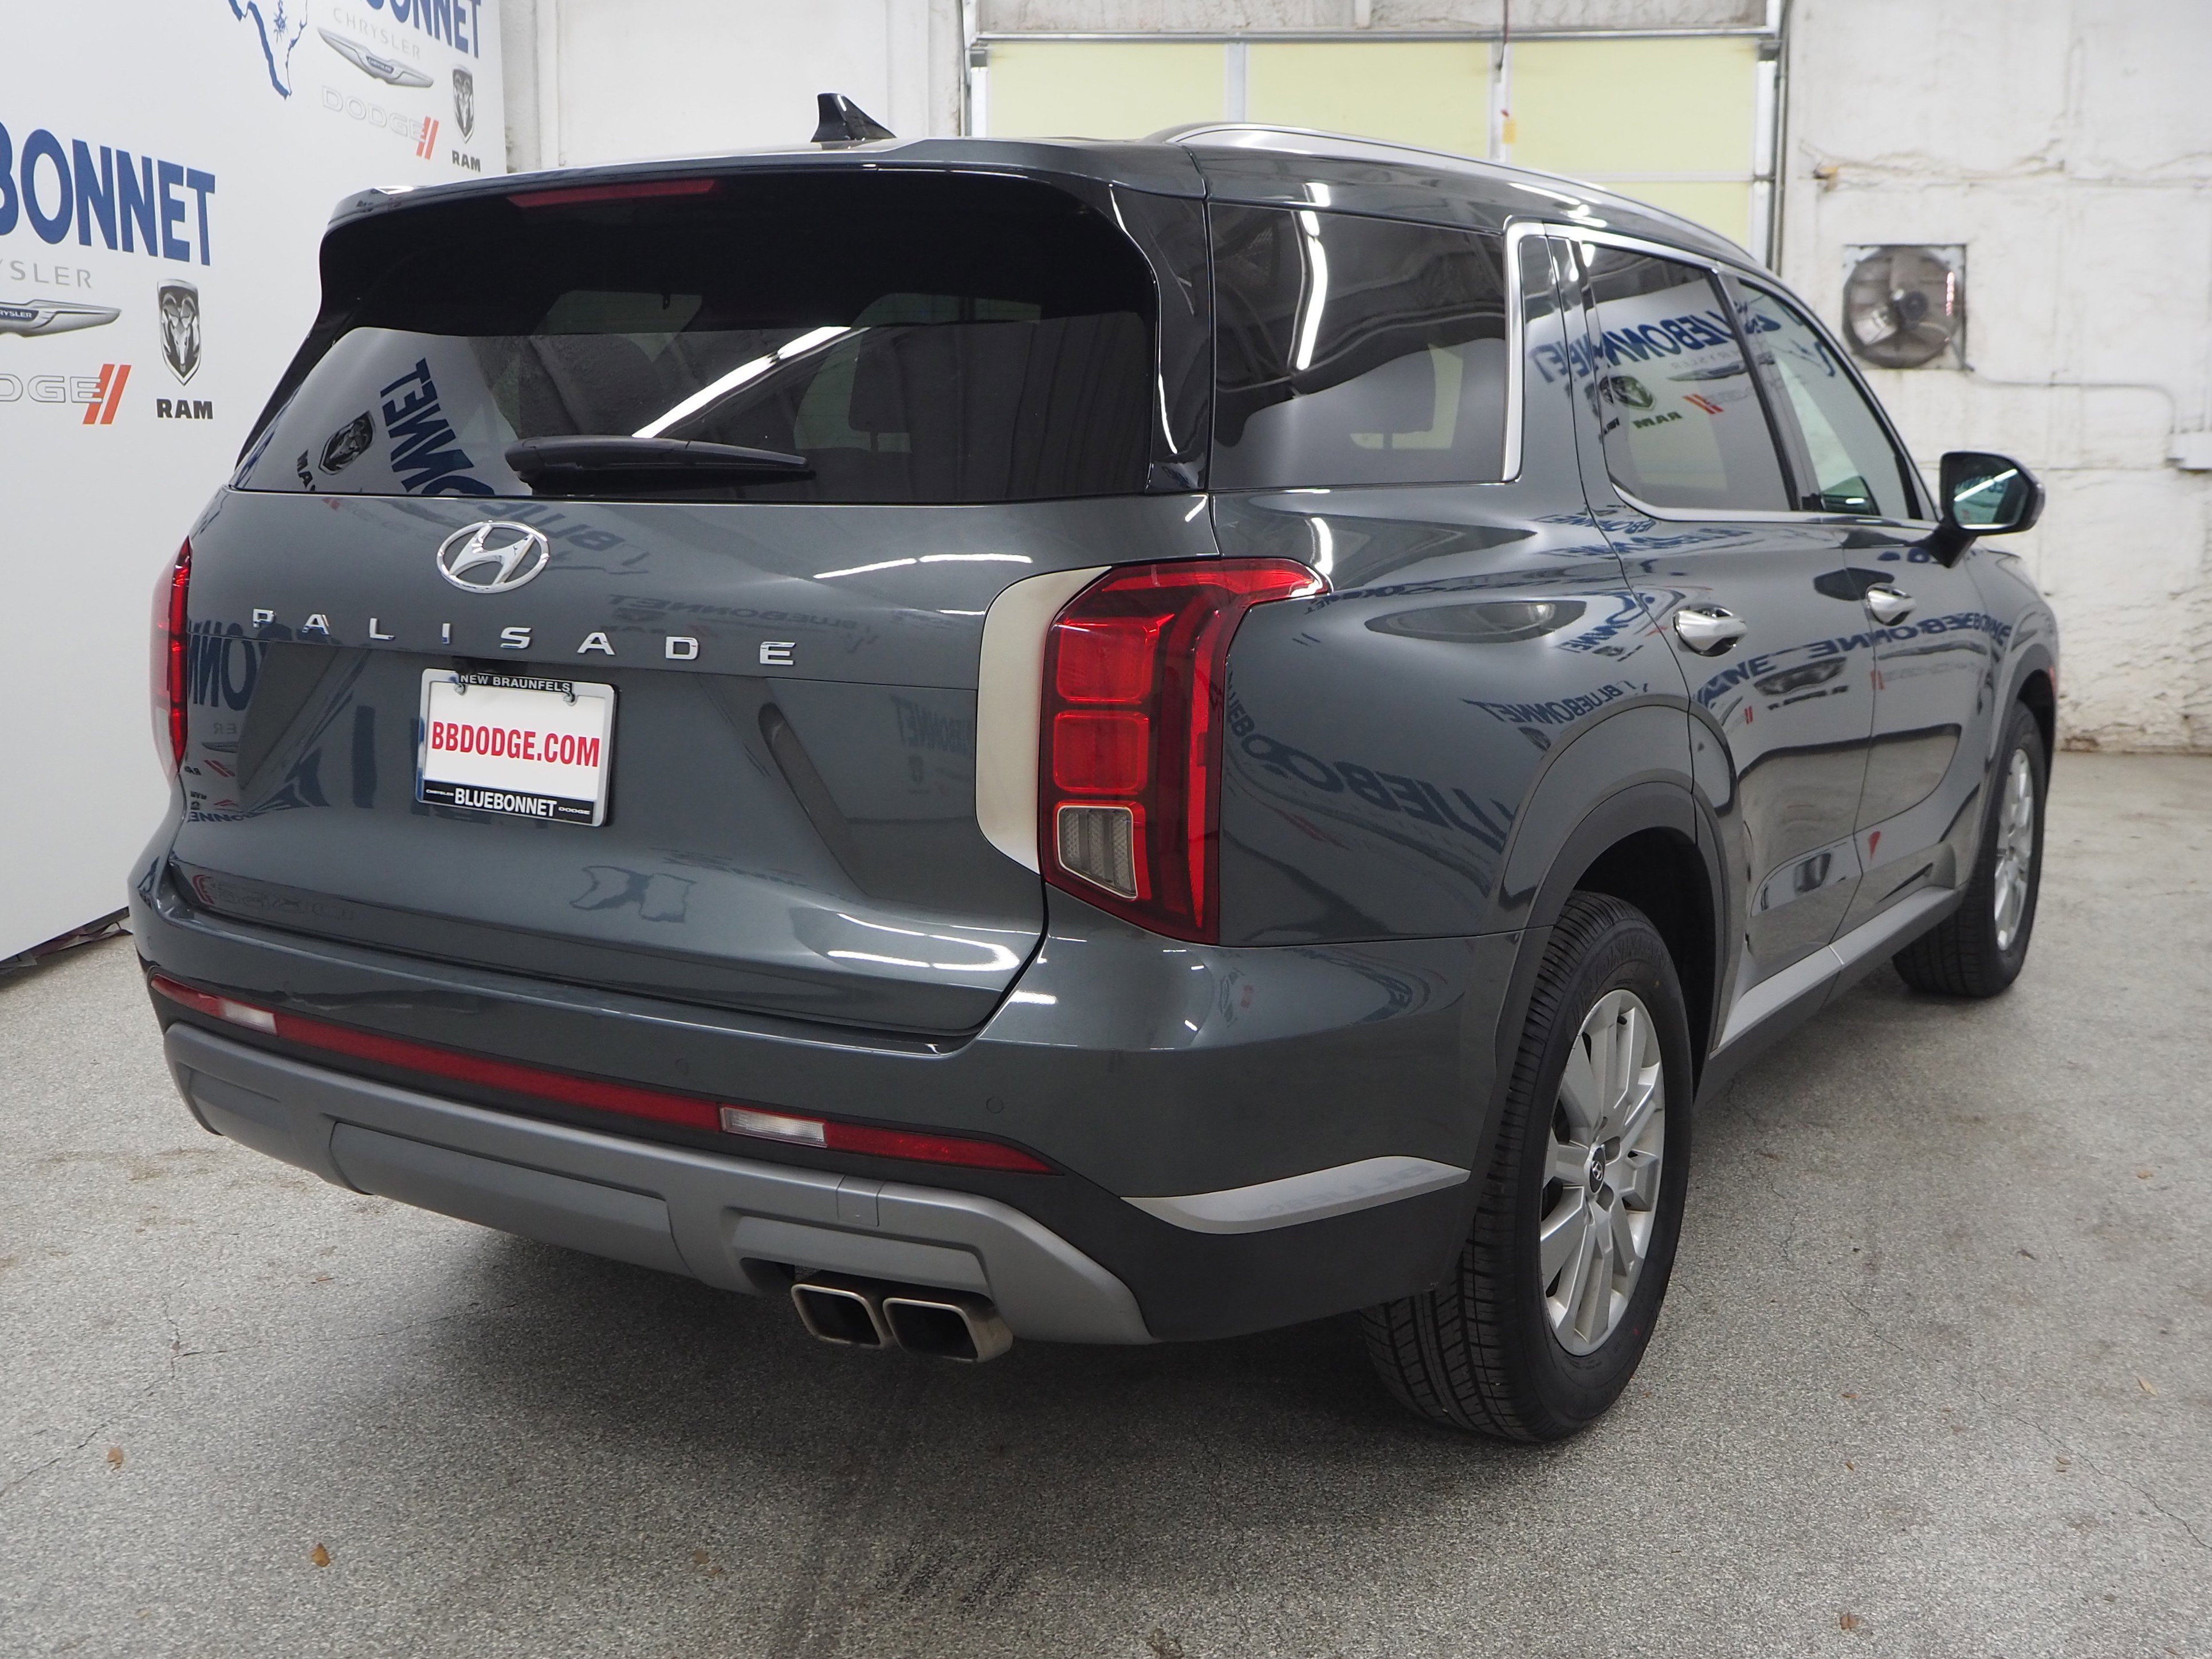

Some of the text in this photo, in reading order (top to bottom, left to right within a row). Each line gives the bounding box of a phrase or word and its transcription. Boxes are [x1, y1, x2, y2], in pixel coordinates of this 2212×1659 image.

[333, 7, 421, 60] CHRYSLER
[321, 85, 426, 143] DODGE
[452, 150, 481, 172] RAM
[156, 398, 213, 419] RAM
[253, 608, 796, 665] PALISADE
[459, 674, 571, 692] NEW BRAUNFELS
[431, 721, 600, 767] BBDODGE.COM
[454, 787, 557, 817] BLUEBONNET
[558, 806, 591, 815] DODGE
